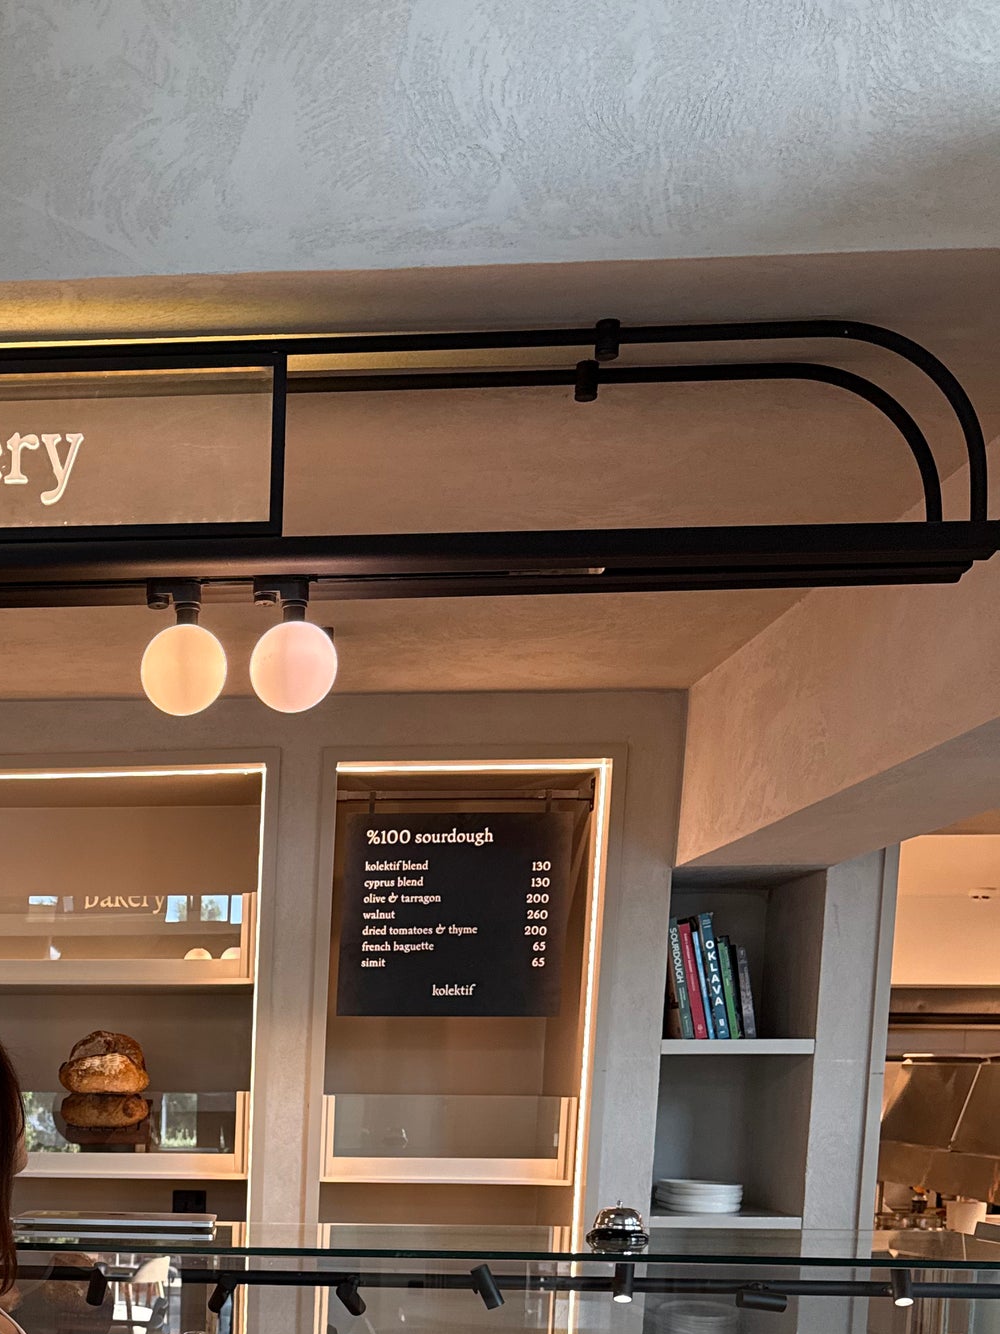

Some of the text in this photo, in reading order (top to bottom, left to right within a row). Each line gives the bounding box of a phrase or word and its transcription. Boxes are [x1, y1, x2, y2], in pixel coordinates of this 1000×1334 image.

[366, 827, 494, 847] %100 sourdough
[365, 859, 552, 872] kolektif blend 130
[363, 876, 550, 890] cyprus blend 130
[363, 891, 550, 905] olive & tarragon 200
[362, 909, 549, 920] walnut 260
[361, 923, 548, 936] dried tomatoes & thyme 200
[361, 941, 546, 953] french baguette 65
[360, 957, 545, 968] simit 65
[669, 927, 685, 984] SOURDOUGH
[705, 940, 724, 1006] OKLAVA
[432, 983, 477, 997] kolektif
